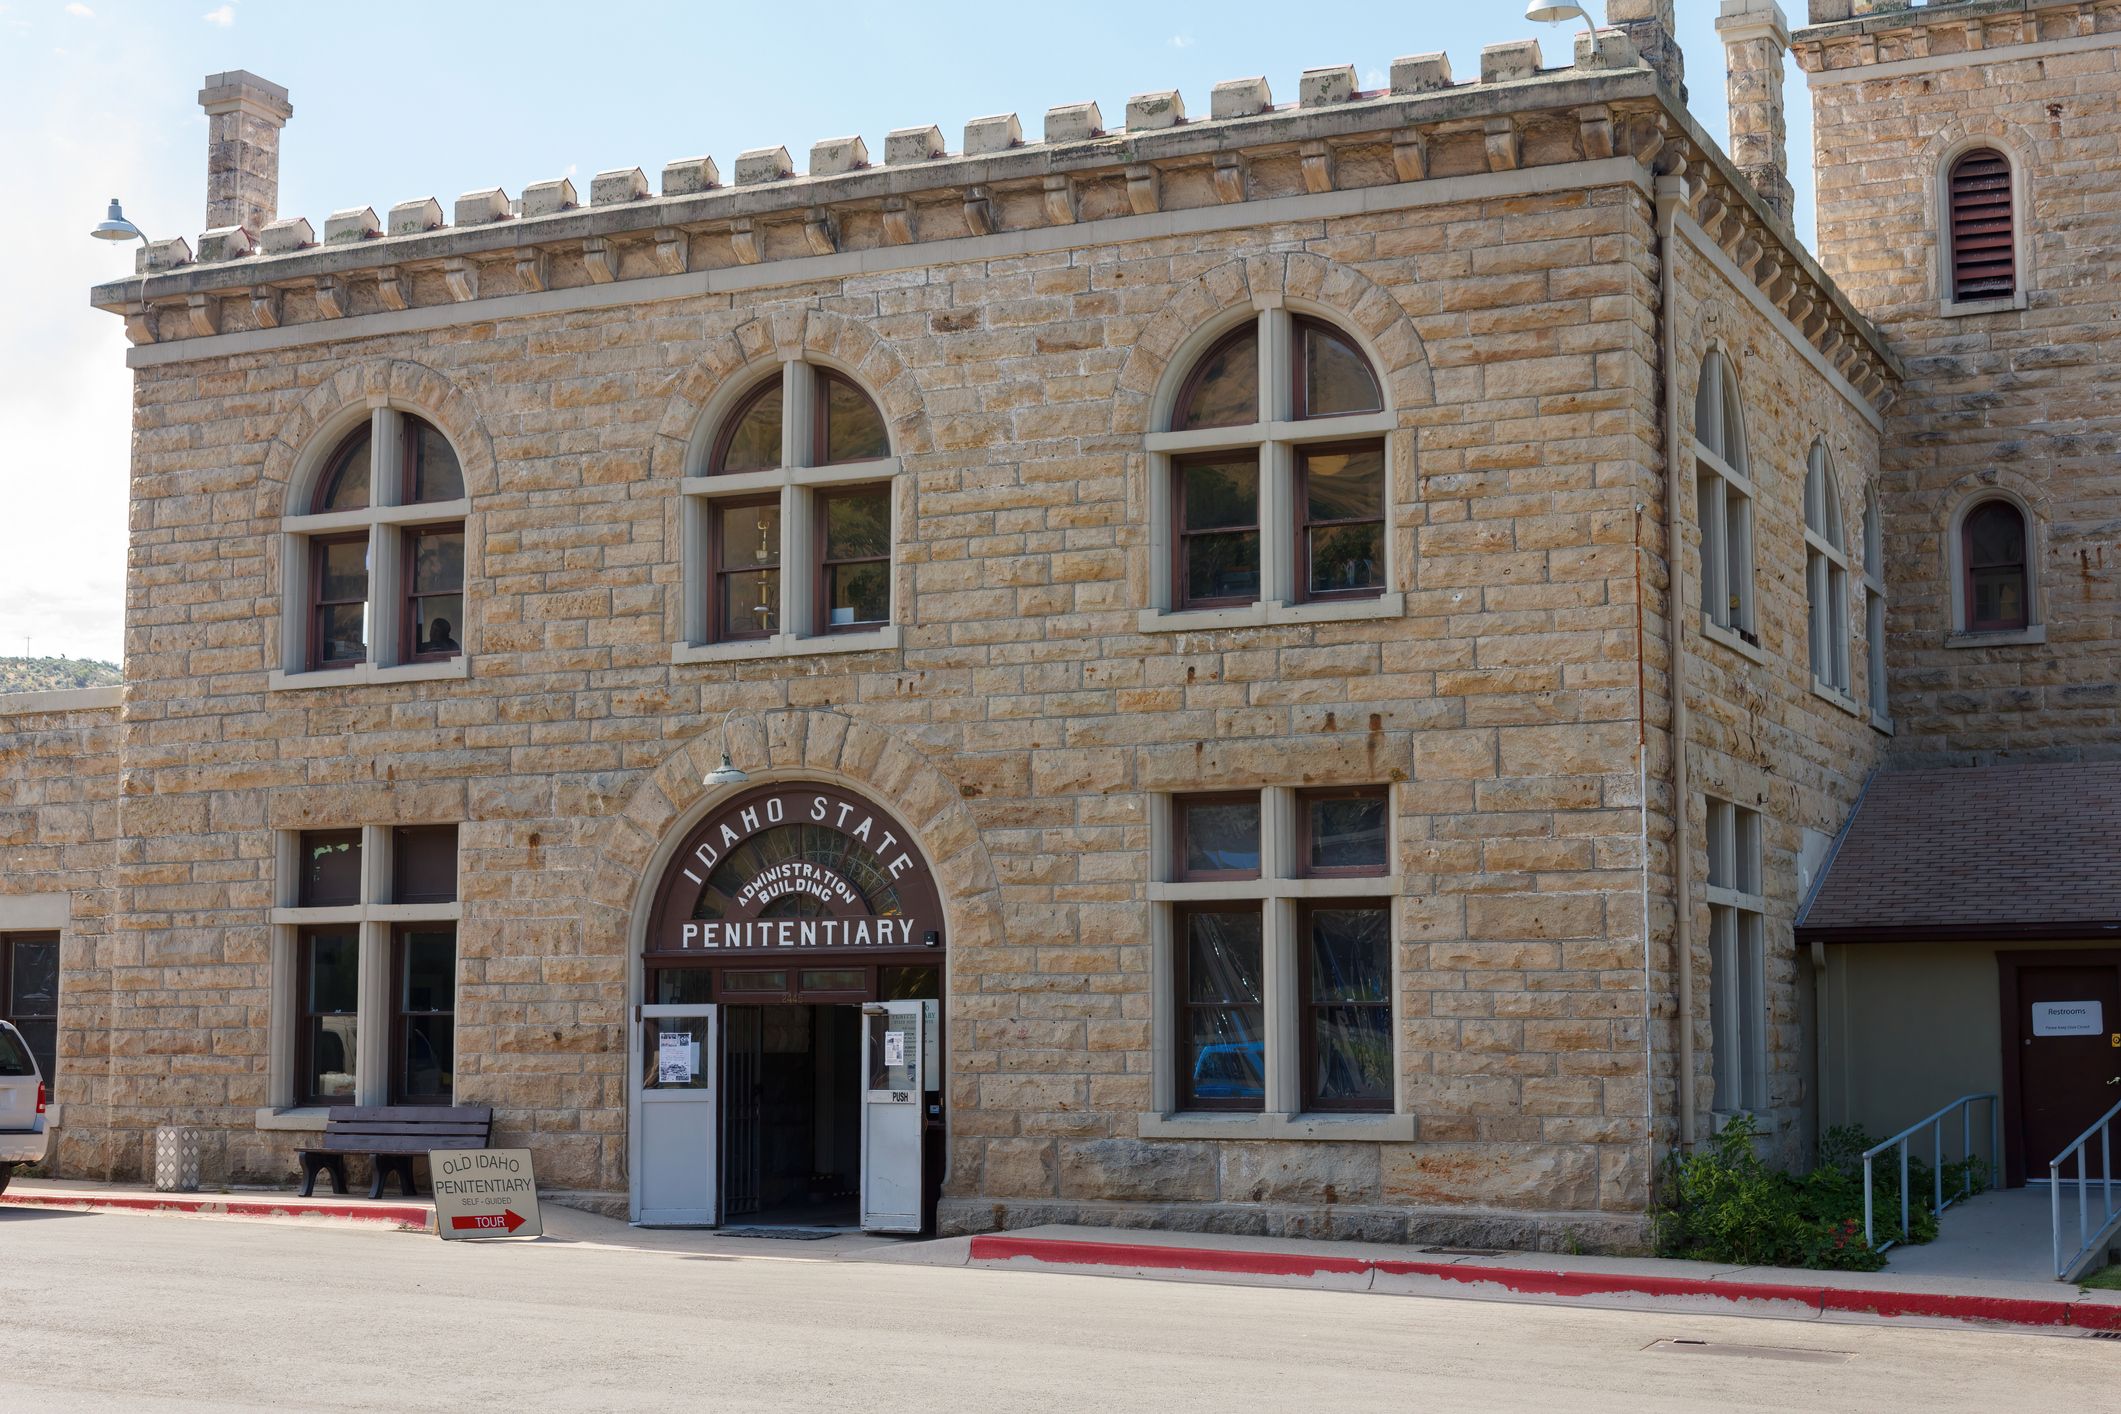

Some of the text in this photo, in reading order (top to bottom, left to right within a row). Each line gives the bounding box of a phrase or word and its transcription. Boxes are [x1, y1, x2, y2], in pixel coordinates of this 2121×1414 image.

[683, 796, 914, 885] IDAHO STATE
[738, 863, 857, 907] ADMINISTRATION
[757, 878, 833, 904] BUILDING
[682, 918, 914, 948] PENITENTIARY
[2048, 1008, 2086, 1016] Restrooms
[892, 1092, 909, 1102] PUSH
[442, 1155, 519, 1174] OLD IDAHO
[435, 1178, 531, 1194] PENITENTIARY
[475, 1216, 505, 1228] TOUR
